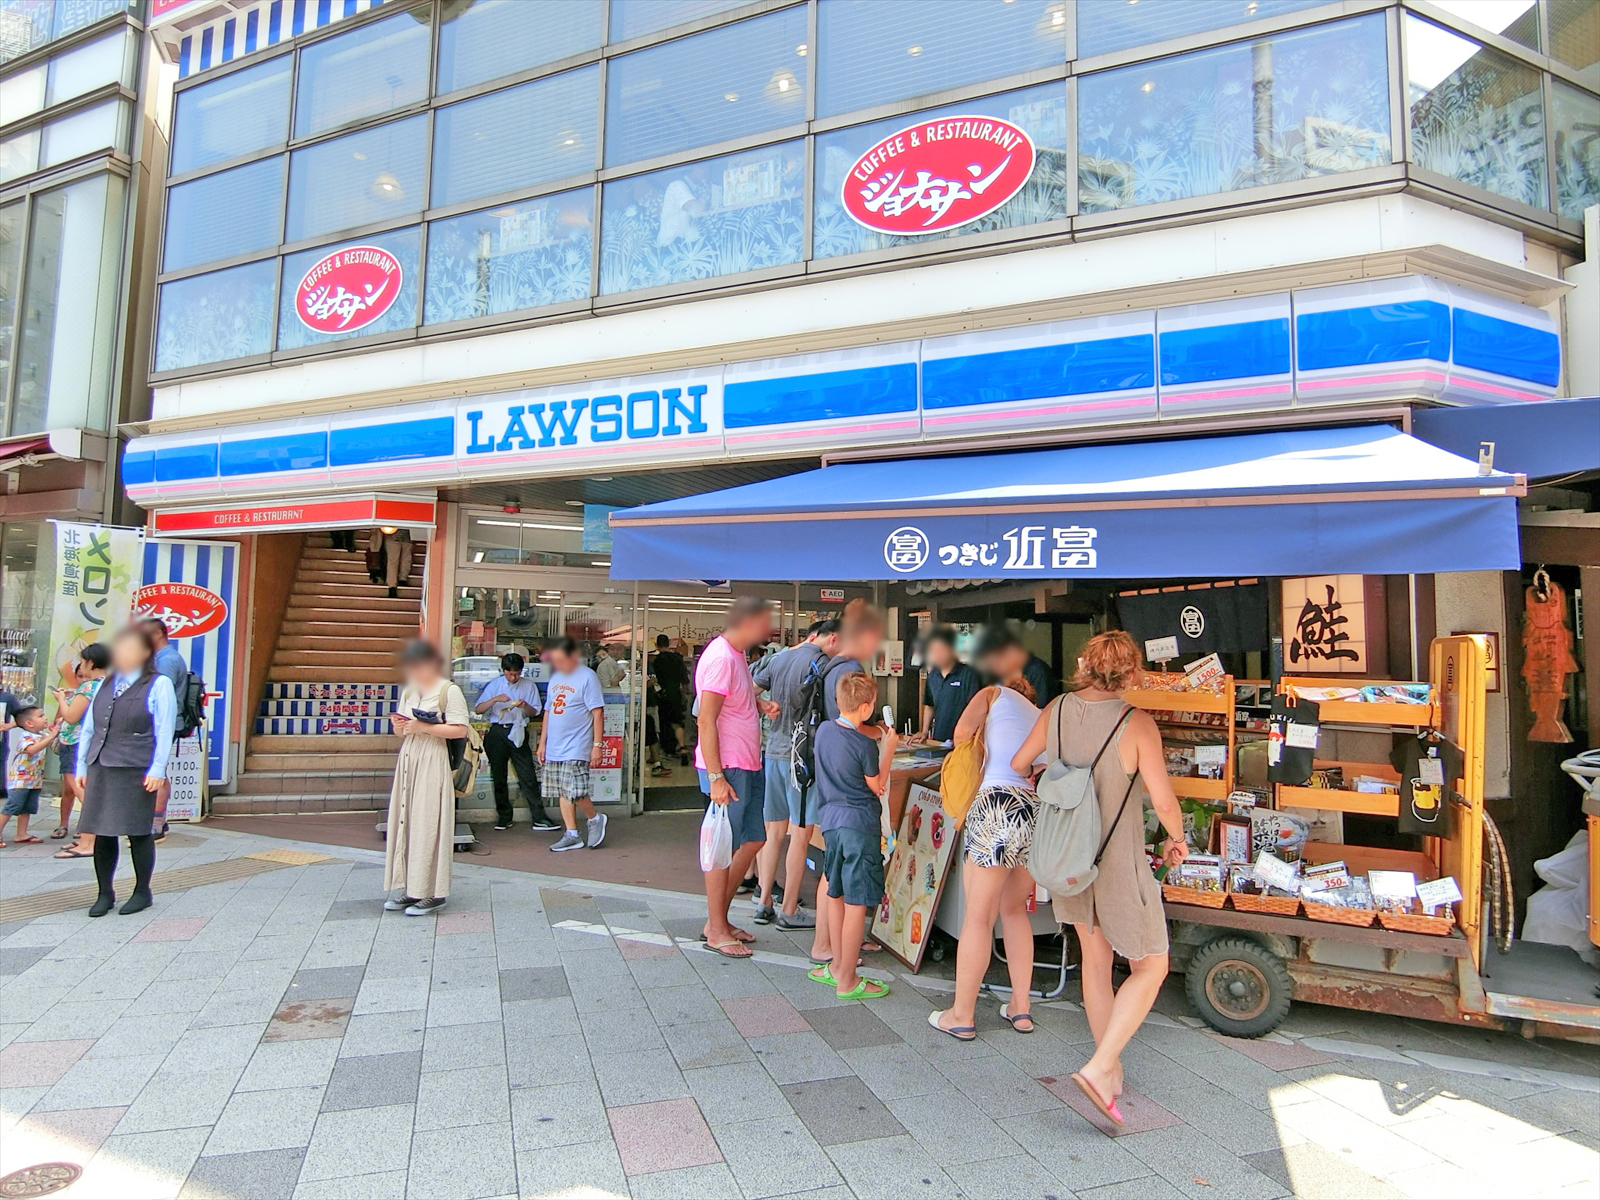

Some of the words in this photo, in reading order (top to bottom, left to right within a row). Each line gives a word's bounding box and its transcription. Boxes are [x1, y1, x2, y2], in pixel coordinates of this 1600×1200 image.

[854, 137, 906, 182] COFFEE
[910, 131, 921, 148] &
[926, 121, 1024, 153] RESTAURANT
[859, 153, 1012, 227] ジョナサン
[303, 259, 333, 292] COFFEE
[335, 256, 341, 269] &
[344, 250, 397, 276] RESTAURANT
[304, 277, 390, 329] ジョナサン
[466, 384, 708, 455] LAWSON
[214, 512, 241, 524] COFFEE
[244, 512, 251, 523] &
[253, 509, 304, 522] RESTAURANT
[938, 541, 999, 567] つきじ
[1002, 525, 1098, 570] 近富
[161, 585, 167, 595] &
[170, 585, 222, 608] RESTAURANT
[1289, 584, 1360, 664] 鮭
[173, 790, 193, 800] 000
